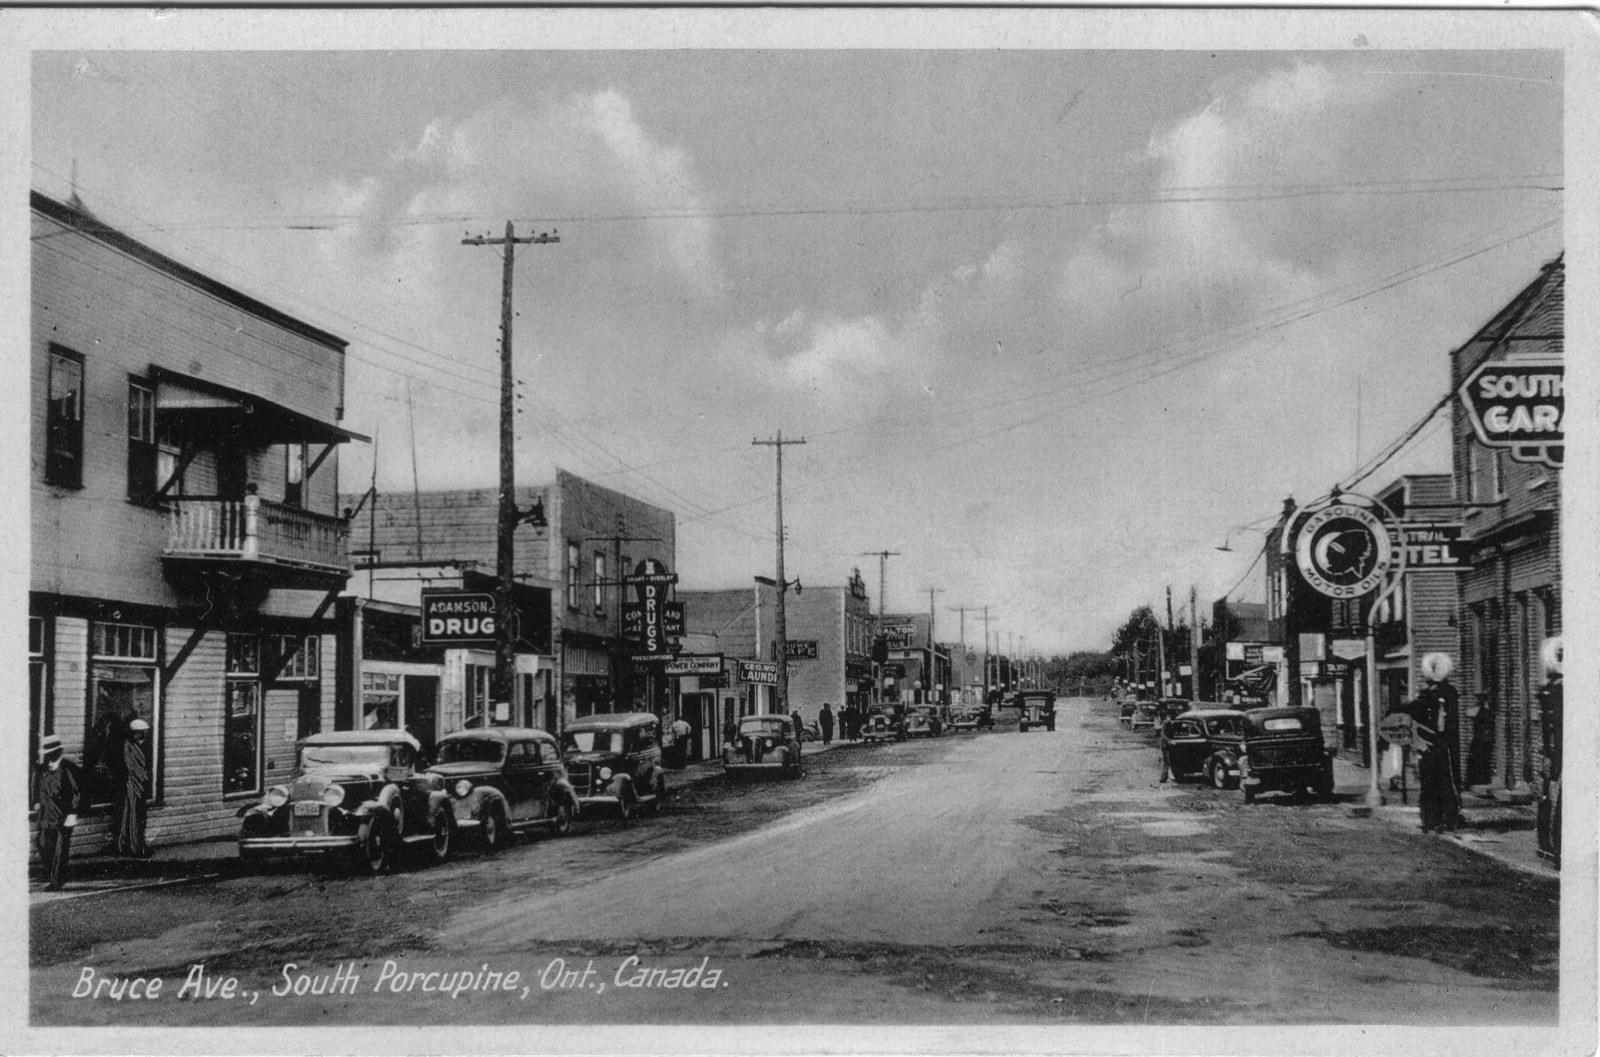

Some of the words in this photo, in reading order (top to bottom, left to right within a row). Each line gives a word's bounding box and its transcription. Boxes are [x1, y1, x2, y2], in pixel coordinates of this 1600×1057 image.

[1483, 405, 1563, 433] GAR
[1306, 507, 1377, 534] GASOLINE
[1390, 545, 1460, 564] OTEL
[1305, 566, 1355, 595] MOTOR
[1361, 561, 1386, 590] OILS
[645, 585, 657, 652] DRUGS
[665, 610, 680, 620] AND
[786, 648, 815, 656] AFE
[665, 661, 689, 670] POWER
[690, 661, 719, 669] COMPANY
